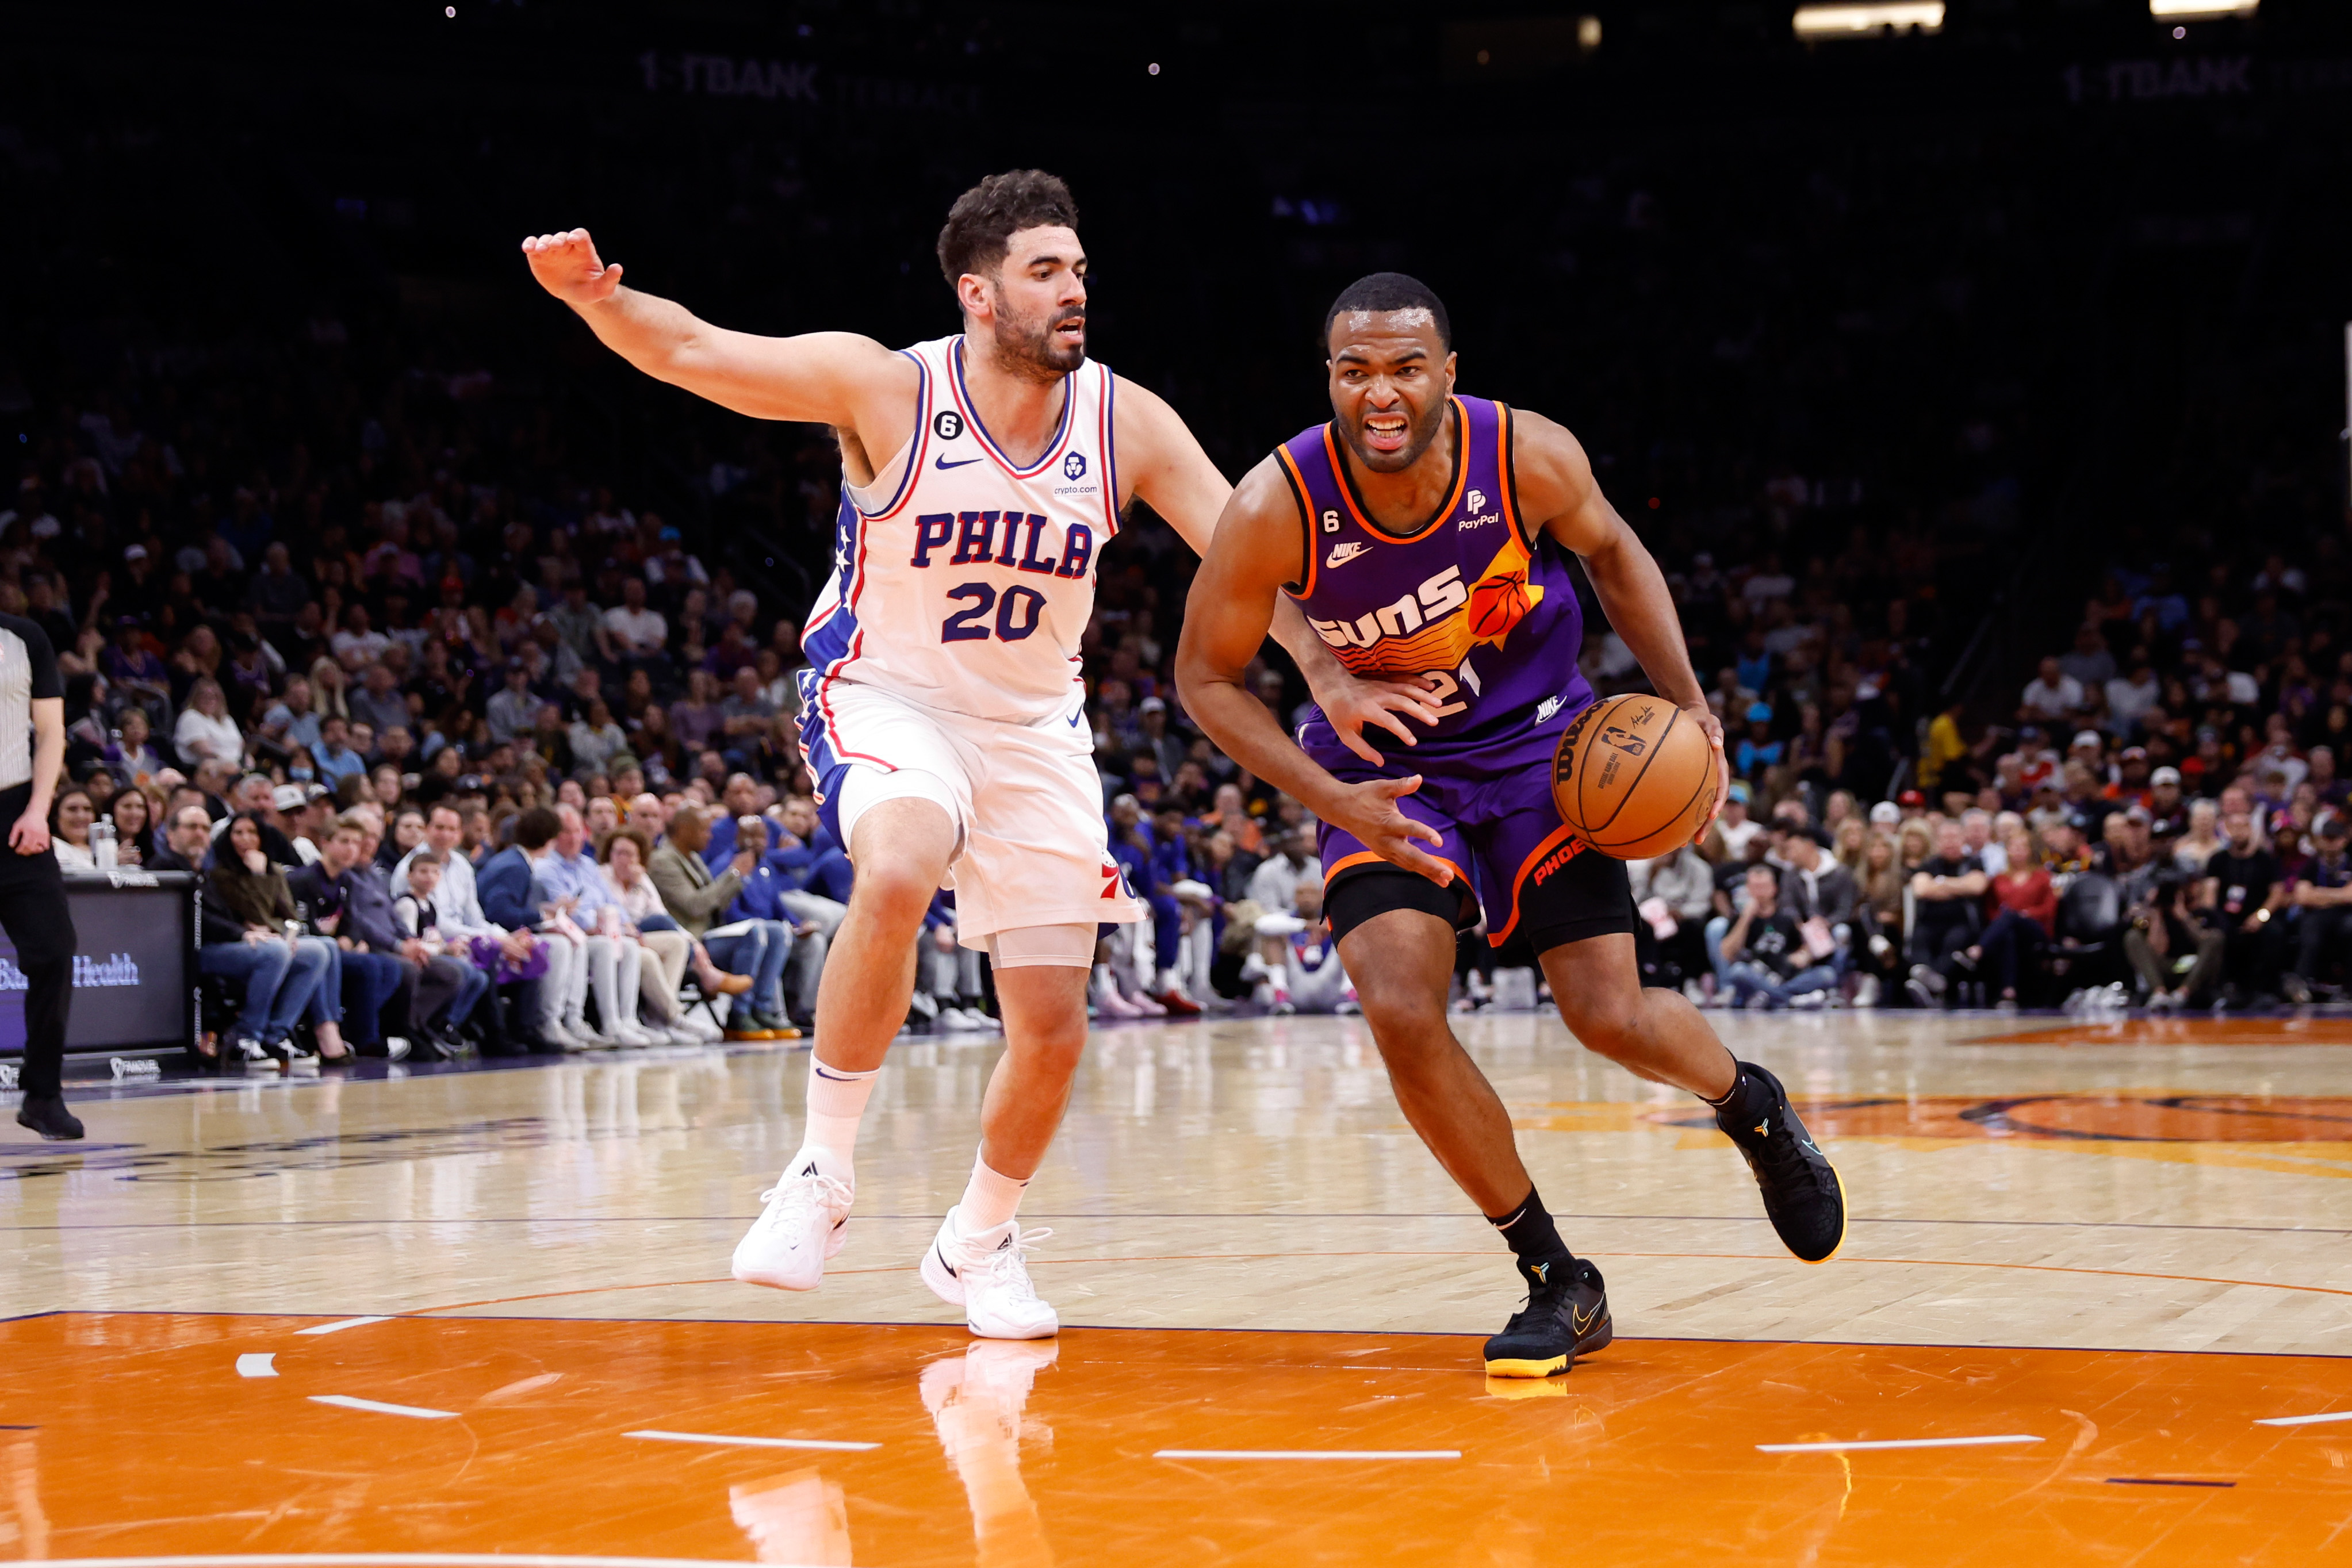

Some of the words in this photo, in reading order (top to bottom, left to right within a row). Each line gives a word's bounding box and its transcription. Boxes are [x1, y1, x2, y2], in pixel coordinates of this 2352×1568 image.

[941, 415, 958, 437] 6
[1054, 484, 1098, 495] crypto.com
[1323, 510, 1340, 532] 6
[1458, 512, 1499, 532] PayPal
[911, 510, 1093, 580] PHILA
[1332, 542, 1362, 558] NIKE
[941, 582, 1047, 643] 20
[1537, 695, 1559, 720] NIKE
[1534, 838, 1587, 887] PHOE
[72, 952, 140, 988] Health
